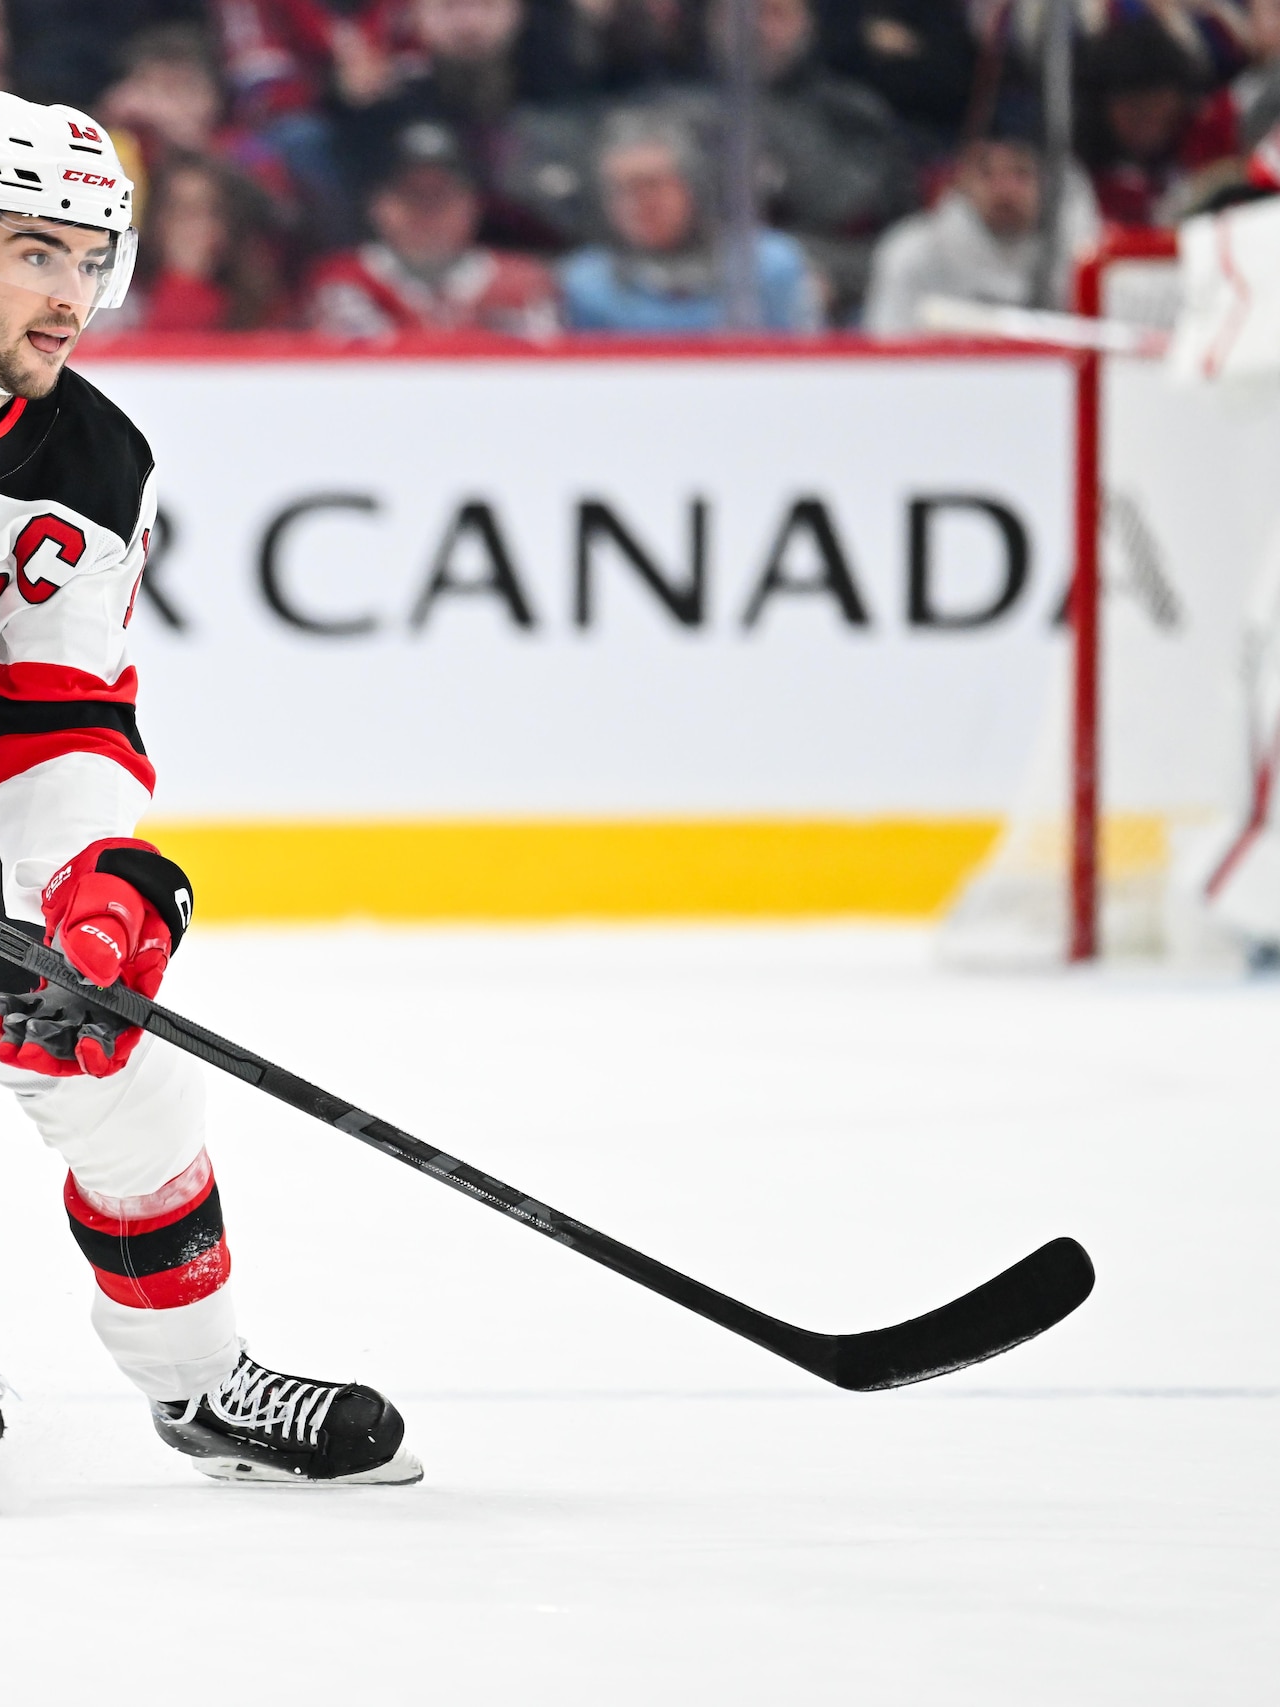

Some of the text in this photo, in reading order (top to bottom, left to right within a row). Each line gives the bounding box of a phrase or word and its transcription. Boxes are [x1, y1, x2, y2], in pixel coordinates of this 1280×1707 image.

[62, 169, 117, 189] CCM
[12, 512, 87, 605] C
[254, 494, 1180, 638] CANADA
[80, 923, 123, 960] CCM
